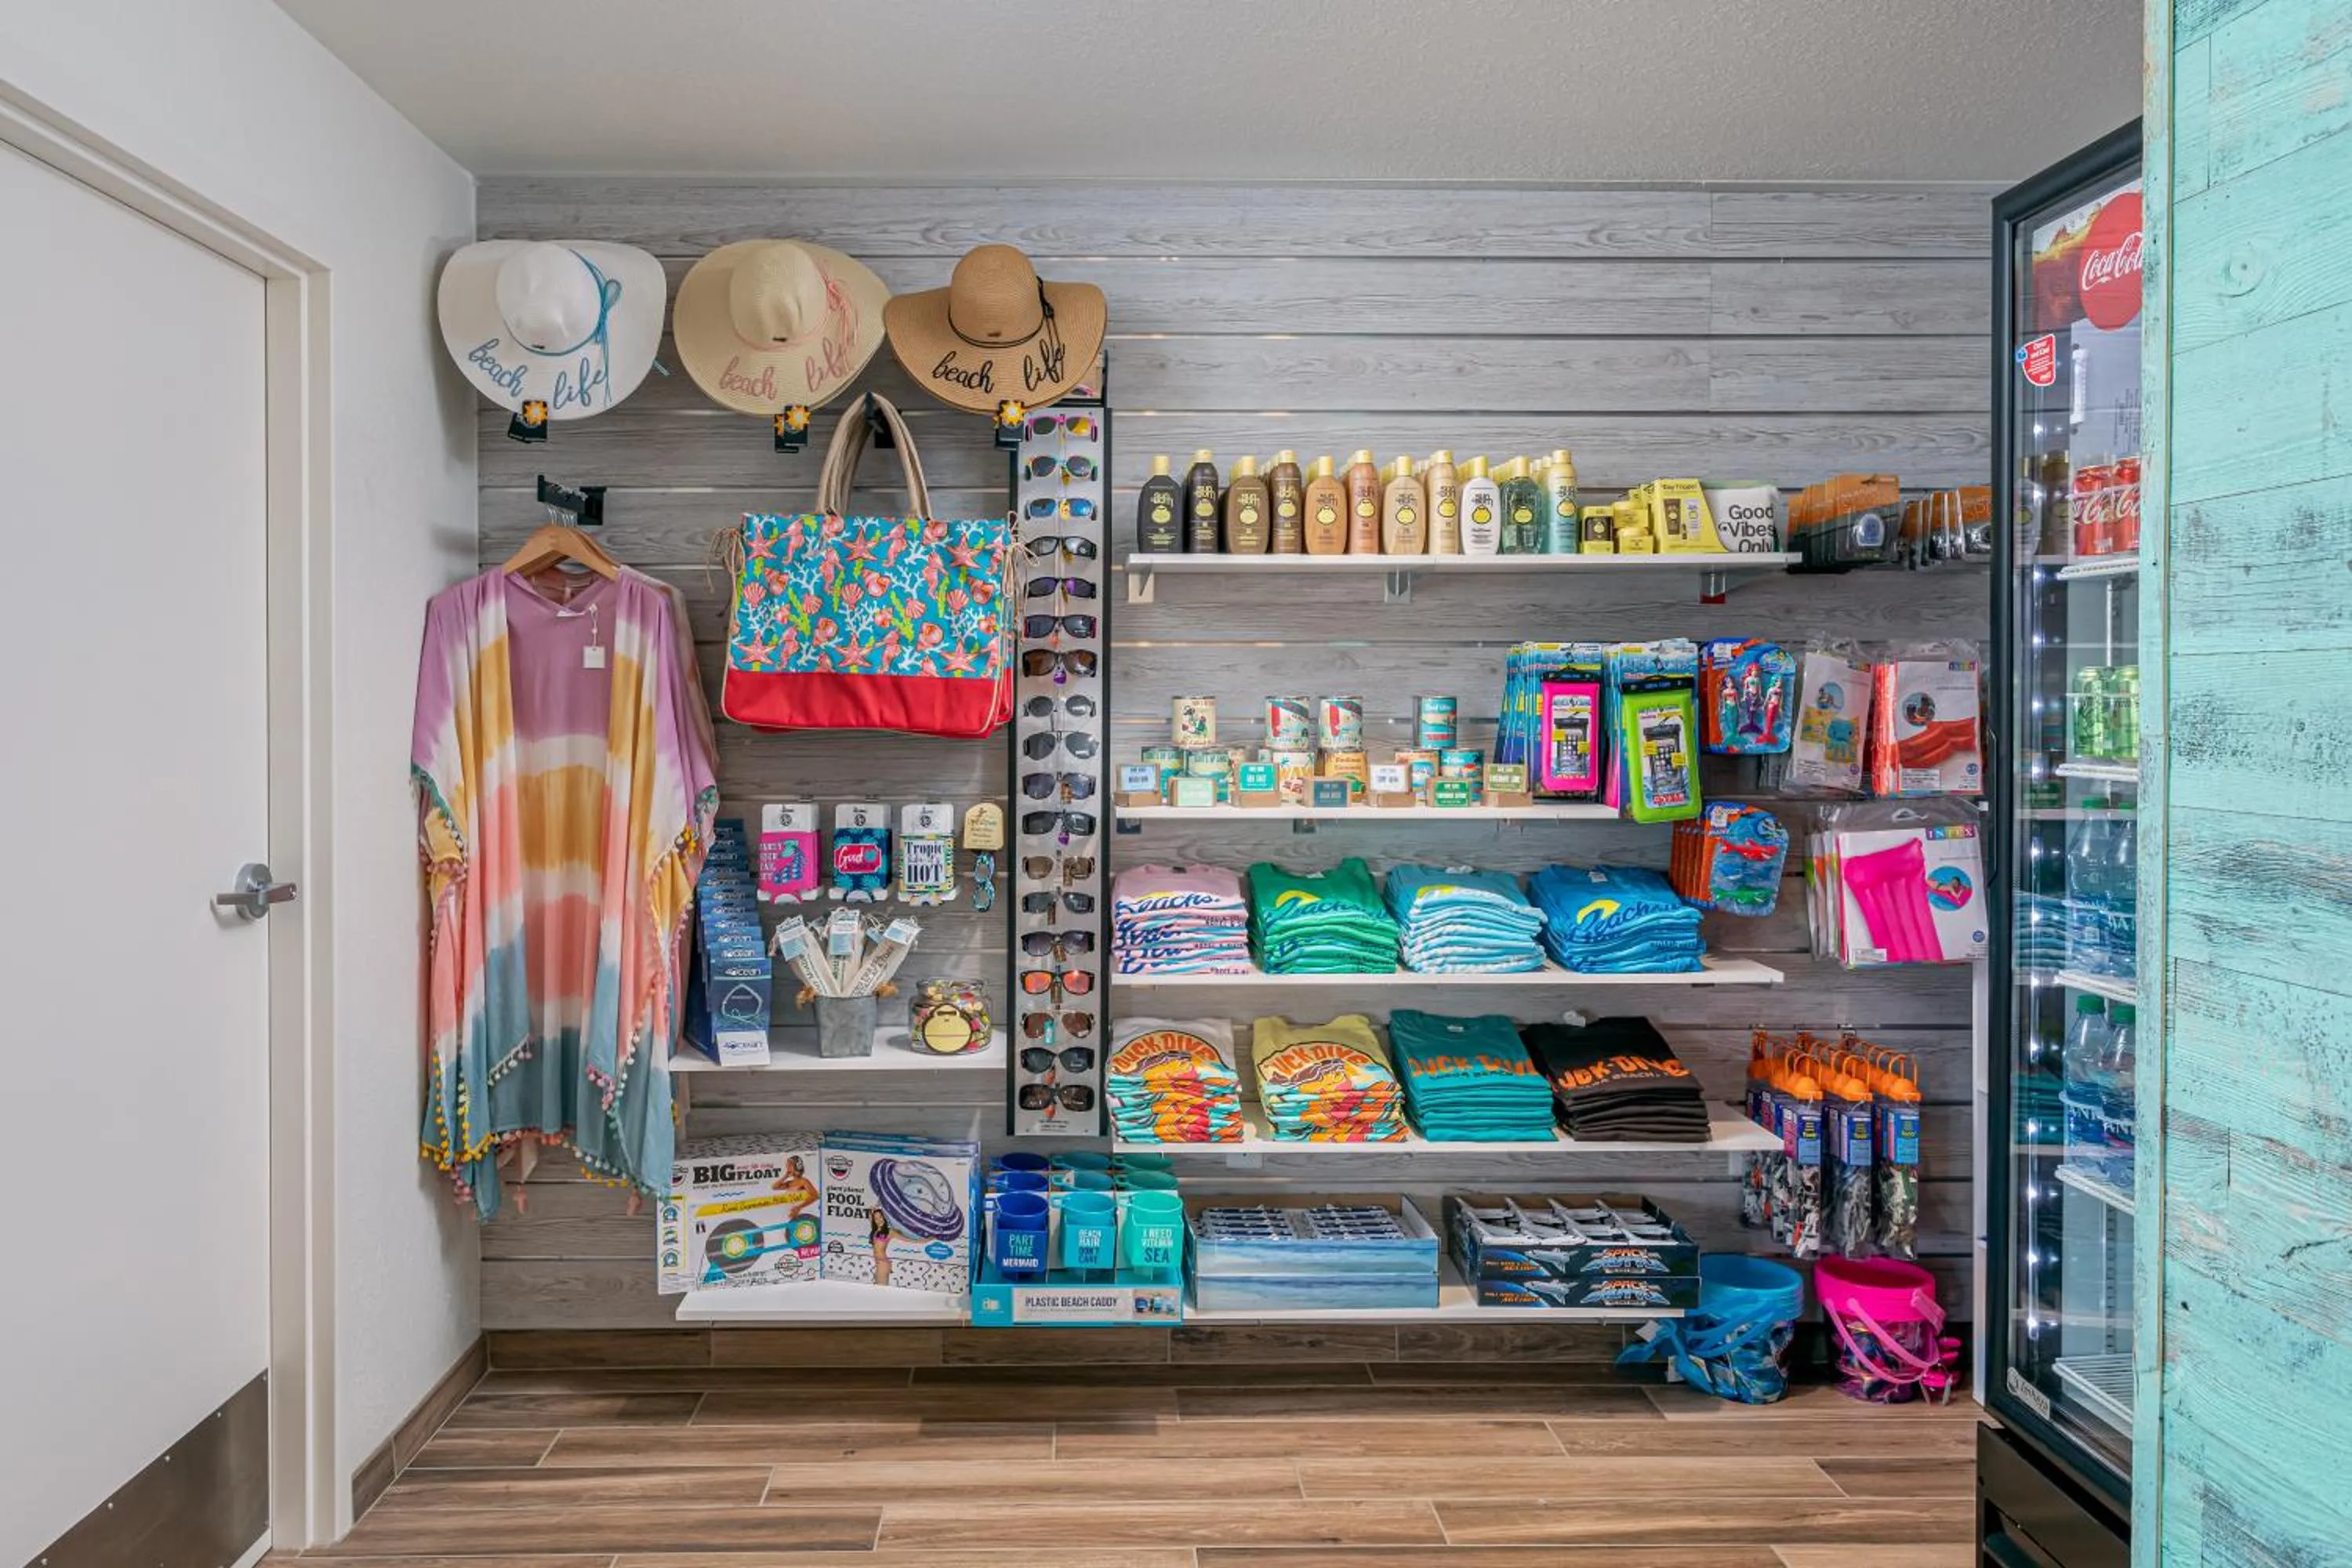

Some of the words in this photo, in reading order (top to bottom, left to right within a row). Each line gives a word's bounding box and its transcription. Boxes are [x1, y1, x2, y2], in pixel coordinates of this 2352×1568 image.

[470, 338, 528, 397] beach
[933, 351, 994, 393] beach
[1024, 339, 1066, 392] life
[719, 356, 777, 401] beach
[1729, 504, 1774, 520] Good
[1727, 522, 1775, 537] Vibes
[907, 865, 943, 884] HOT
[725, 967, 761, 976] 4ocean
[693, 1163, 736, 1184] BIG
[737, 1167, 782, 1181] FLOAT
[827, 1192, 865, 1206] POOL
[827, 1205, 872, 1219] FLOAT
[1009, 1234, 1035, 1246] PART
[1079, 1229, 1102, 1238] BEACH
[1149, 1229, 1172, 1238] NEED
[1079, 1237, 1100, 1247] HAIR
[1009, 1245, 1033, 1257] TIME
[1144, 1249, 1171, 1263] SEA
[1002, 1258, 1039, 1268] MERMAID
[1025, 1296, 1059, 1307] PLASTIC
[1061, 1296, 1090, 1307] BEACH
[1091, 1296, 1117, 1307] CADDY
